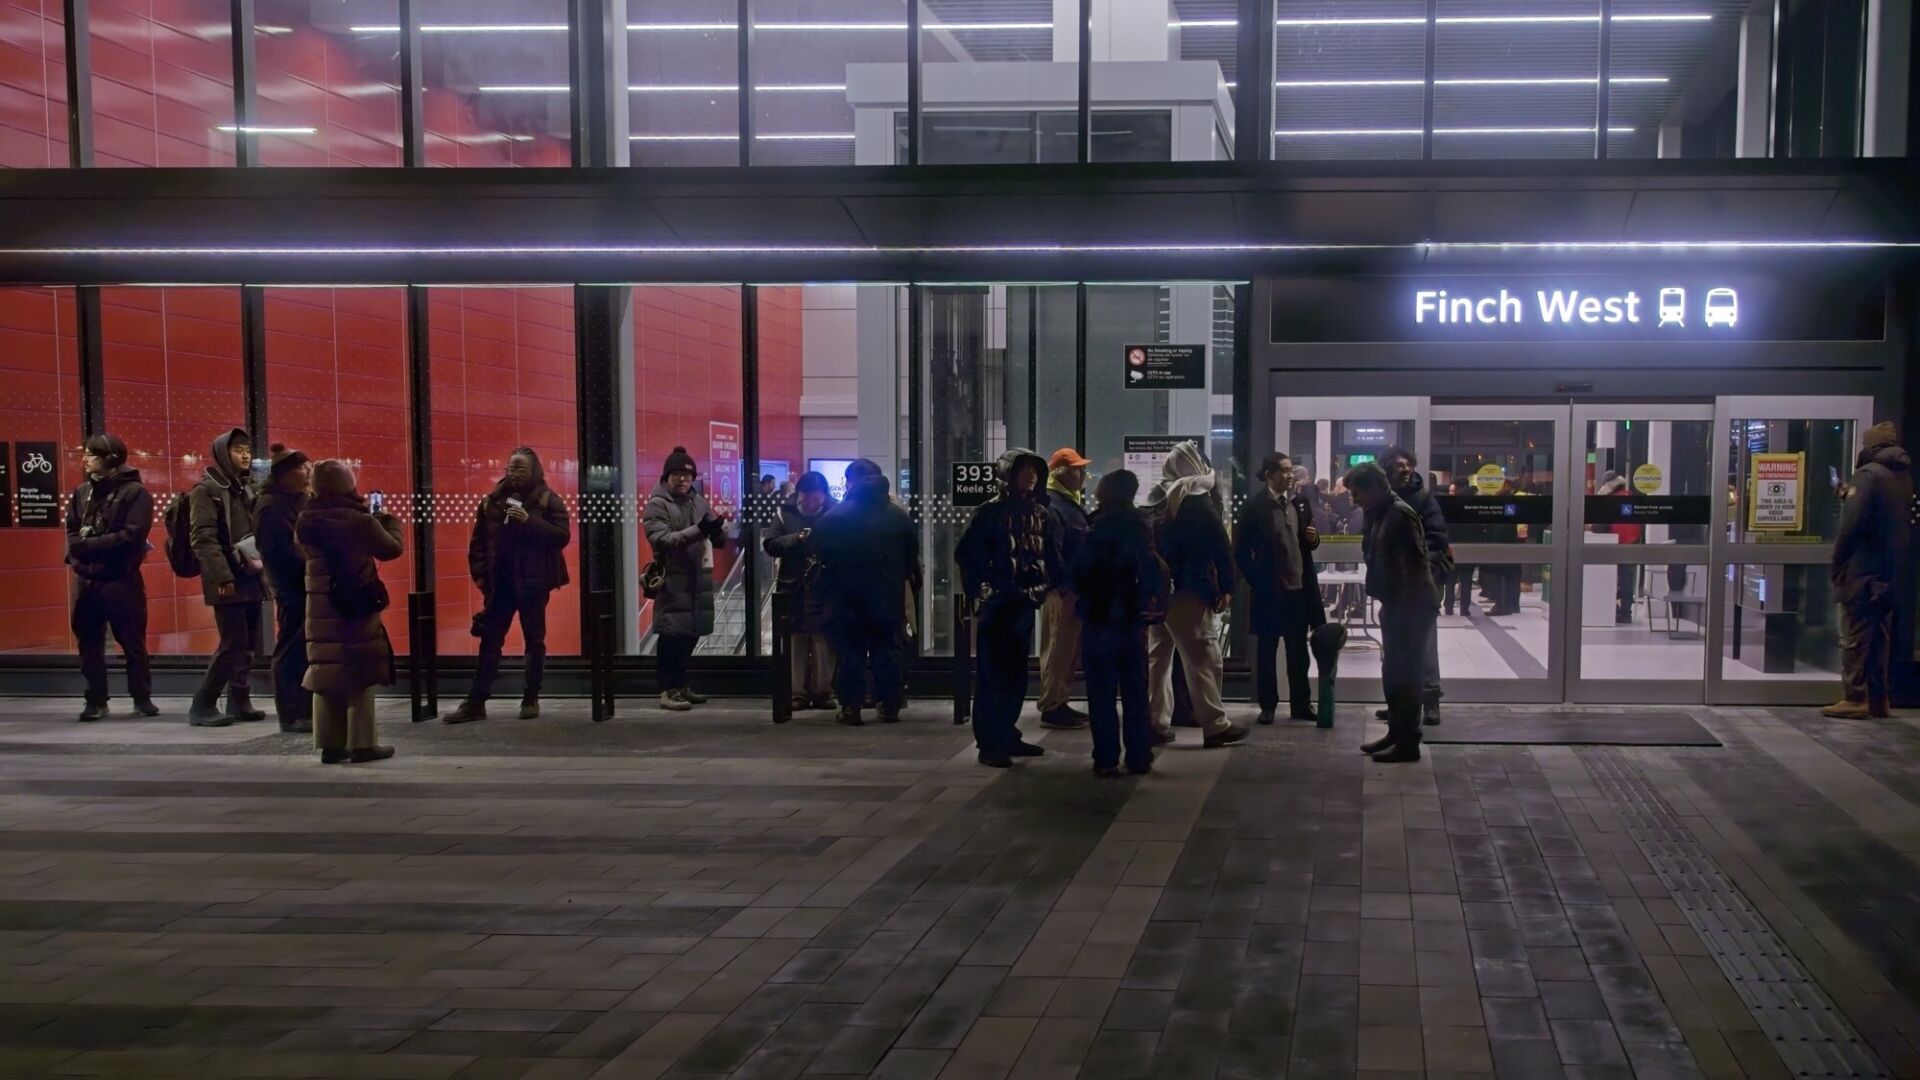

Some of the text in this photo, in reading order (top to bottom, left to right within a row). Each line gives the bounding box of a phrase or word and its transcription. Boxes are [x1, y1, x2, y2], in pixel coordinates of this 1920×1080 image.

[1416, 289, 1640, 323] Finch West
[1758, 463, 1797, 472] WARNING
[20, 487, 38, 495] Bicycle
[956, 484, 997, 493] Keele St
